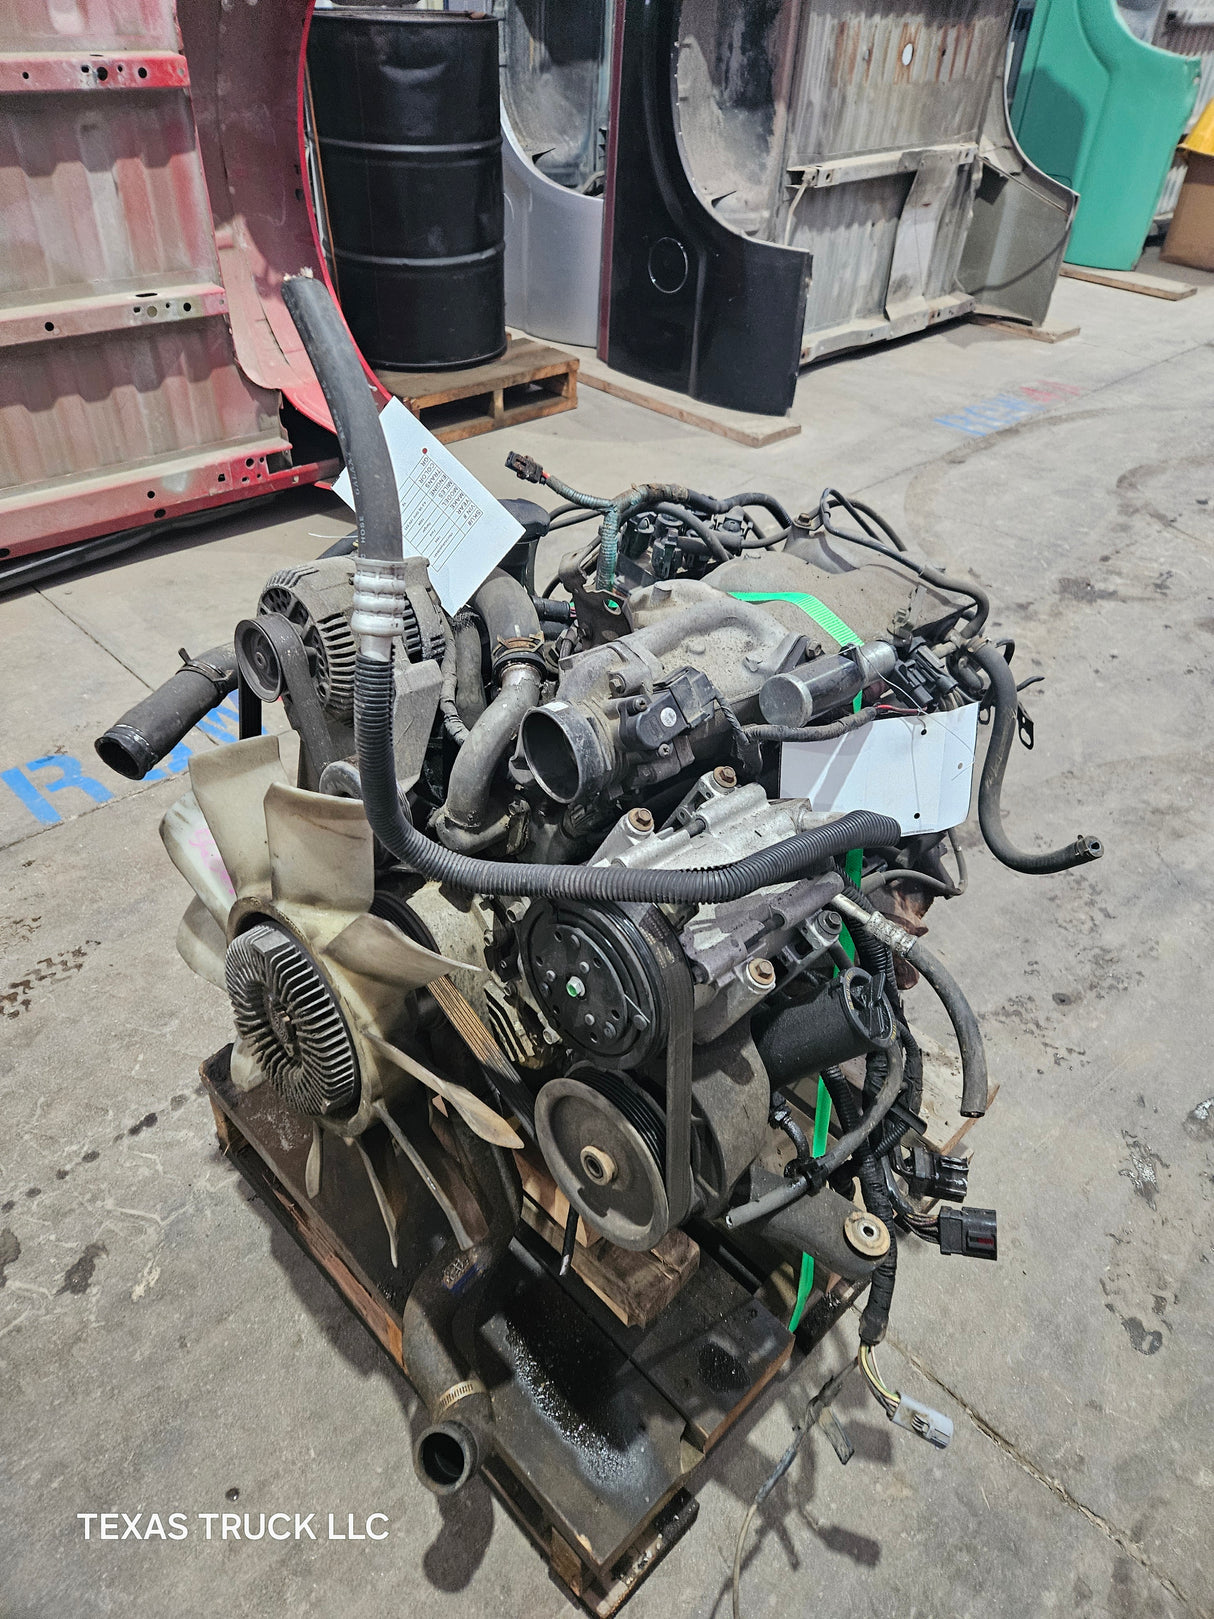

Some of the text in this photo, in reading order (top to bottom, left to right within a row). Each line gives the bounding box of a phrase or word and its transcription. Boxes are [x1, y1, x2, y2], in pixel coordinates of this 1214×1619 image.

[420, 457, 429, 466] GR
[419, 462, 435, 484] COLOR
[425, 469, 441, 489] TRANS
[430, 474, 447, 497] ENGINE
[438, 480, 453, 499] MILES
[441, 485, 459, 506] MODEL
[450, 492, 464, 509] MAKE
[456, 499, 470, 515] YEAR
[466, 504, 476, 515] VIN
[467, 509, 481, 526] SKU#
